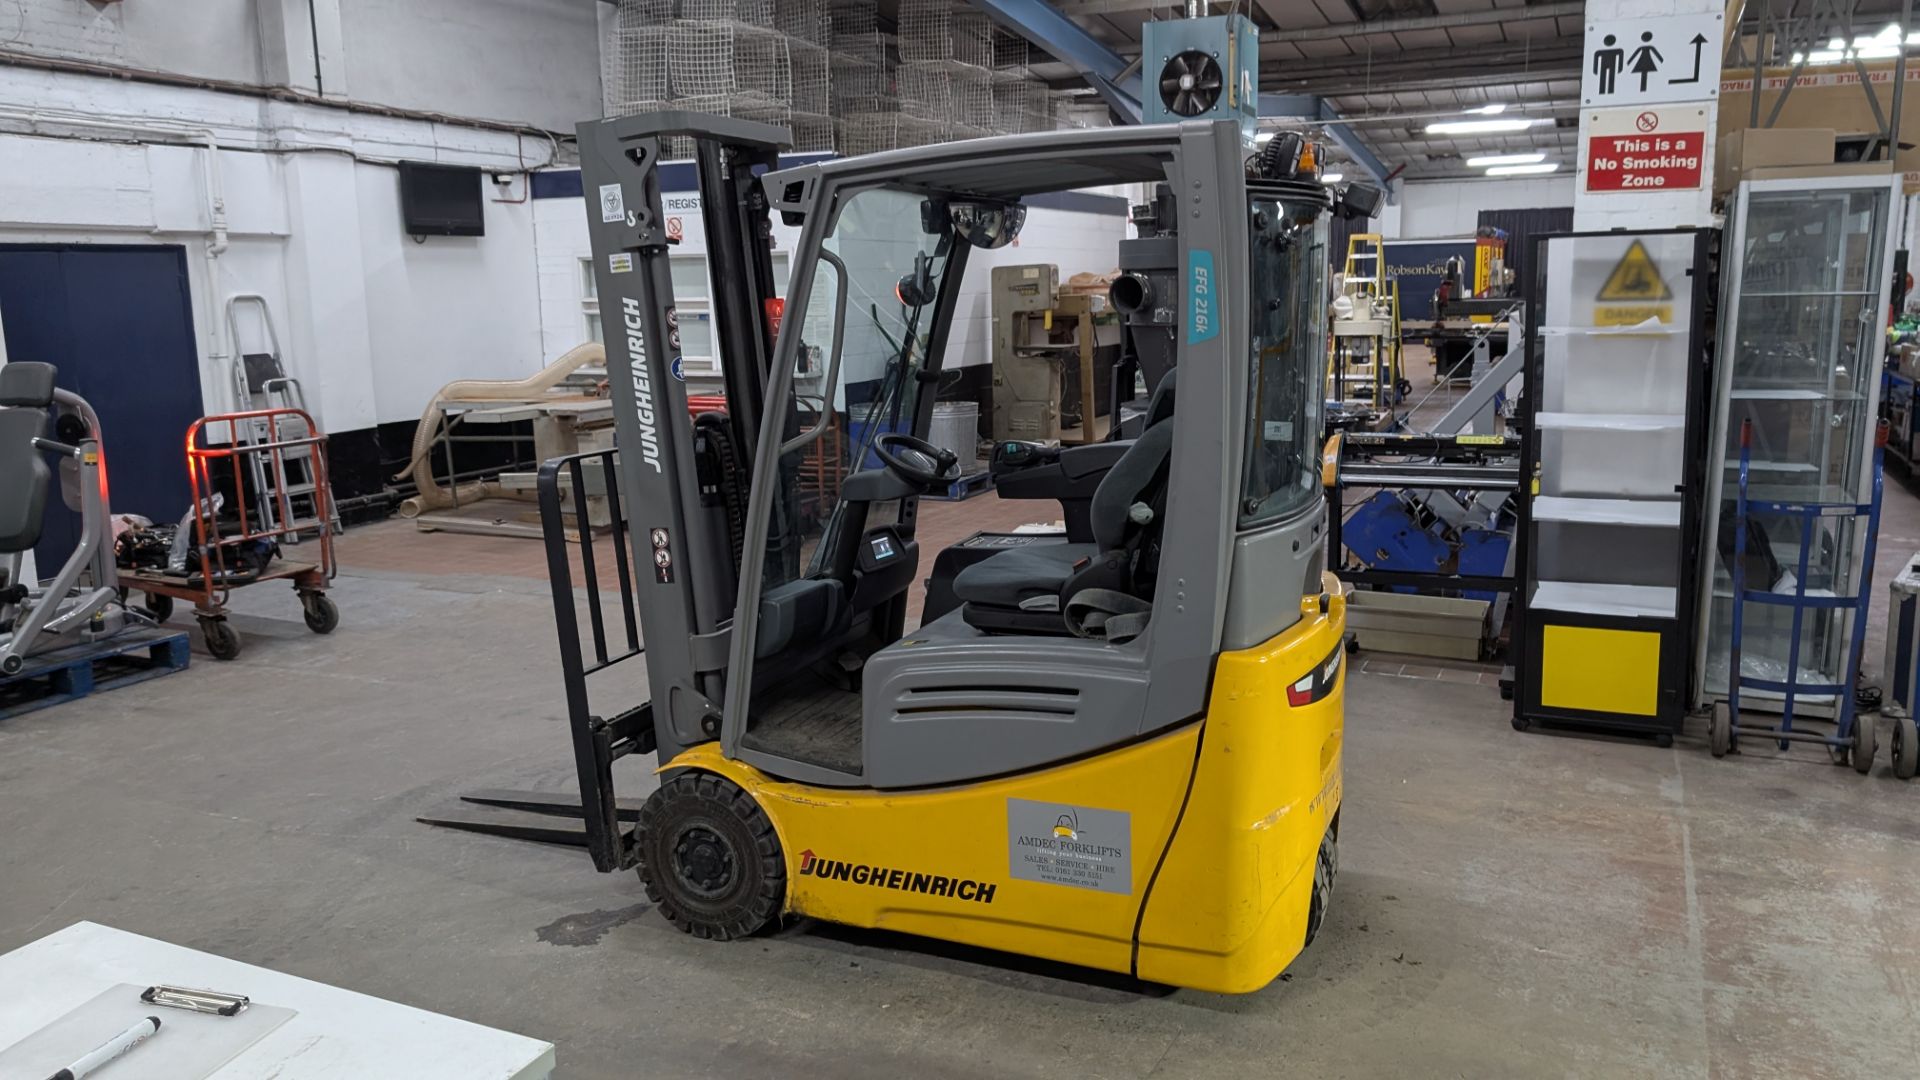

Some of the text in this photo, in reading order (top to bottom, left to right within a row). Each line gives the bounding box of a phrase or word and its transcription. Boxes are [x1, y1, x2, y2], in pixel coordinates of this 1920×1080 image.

[1768, 76, 1818, 89] FRAILE
[1613, 138, 1686, 153] This is a
[1594, 155, 1697, 170] No Smoking
[1621, 174, 1665, 187] Zone
[1195, 266, 1208, 334] EFG 216k
[622, 297, 662, 473] JUNGHEINRICH
[1017, 835, 1122, 858] AMDEC FORKLIFTS
[1024, 855, 1116, 874] SALES SERVICE HIRE
[799, 852, 997, 904] JUNGHEINRICH
